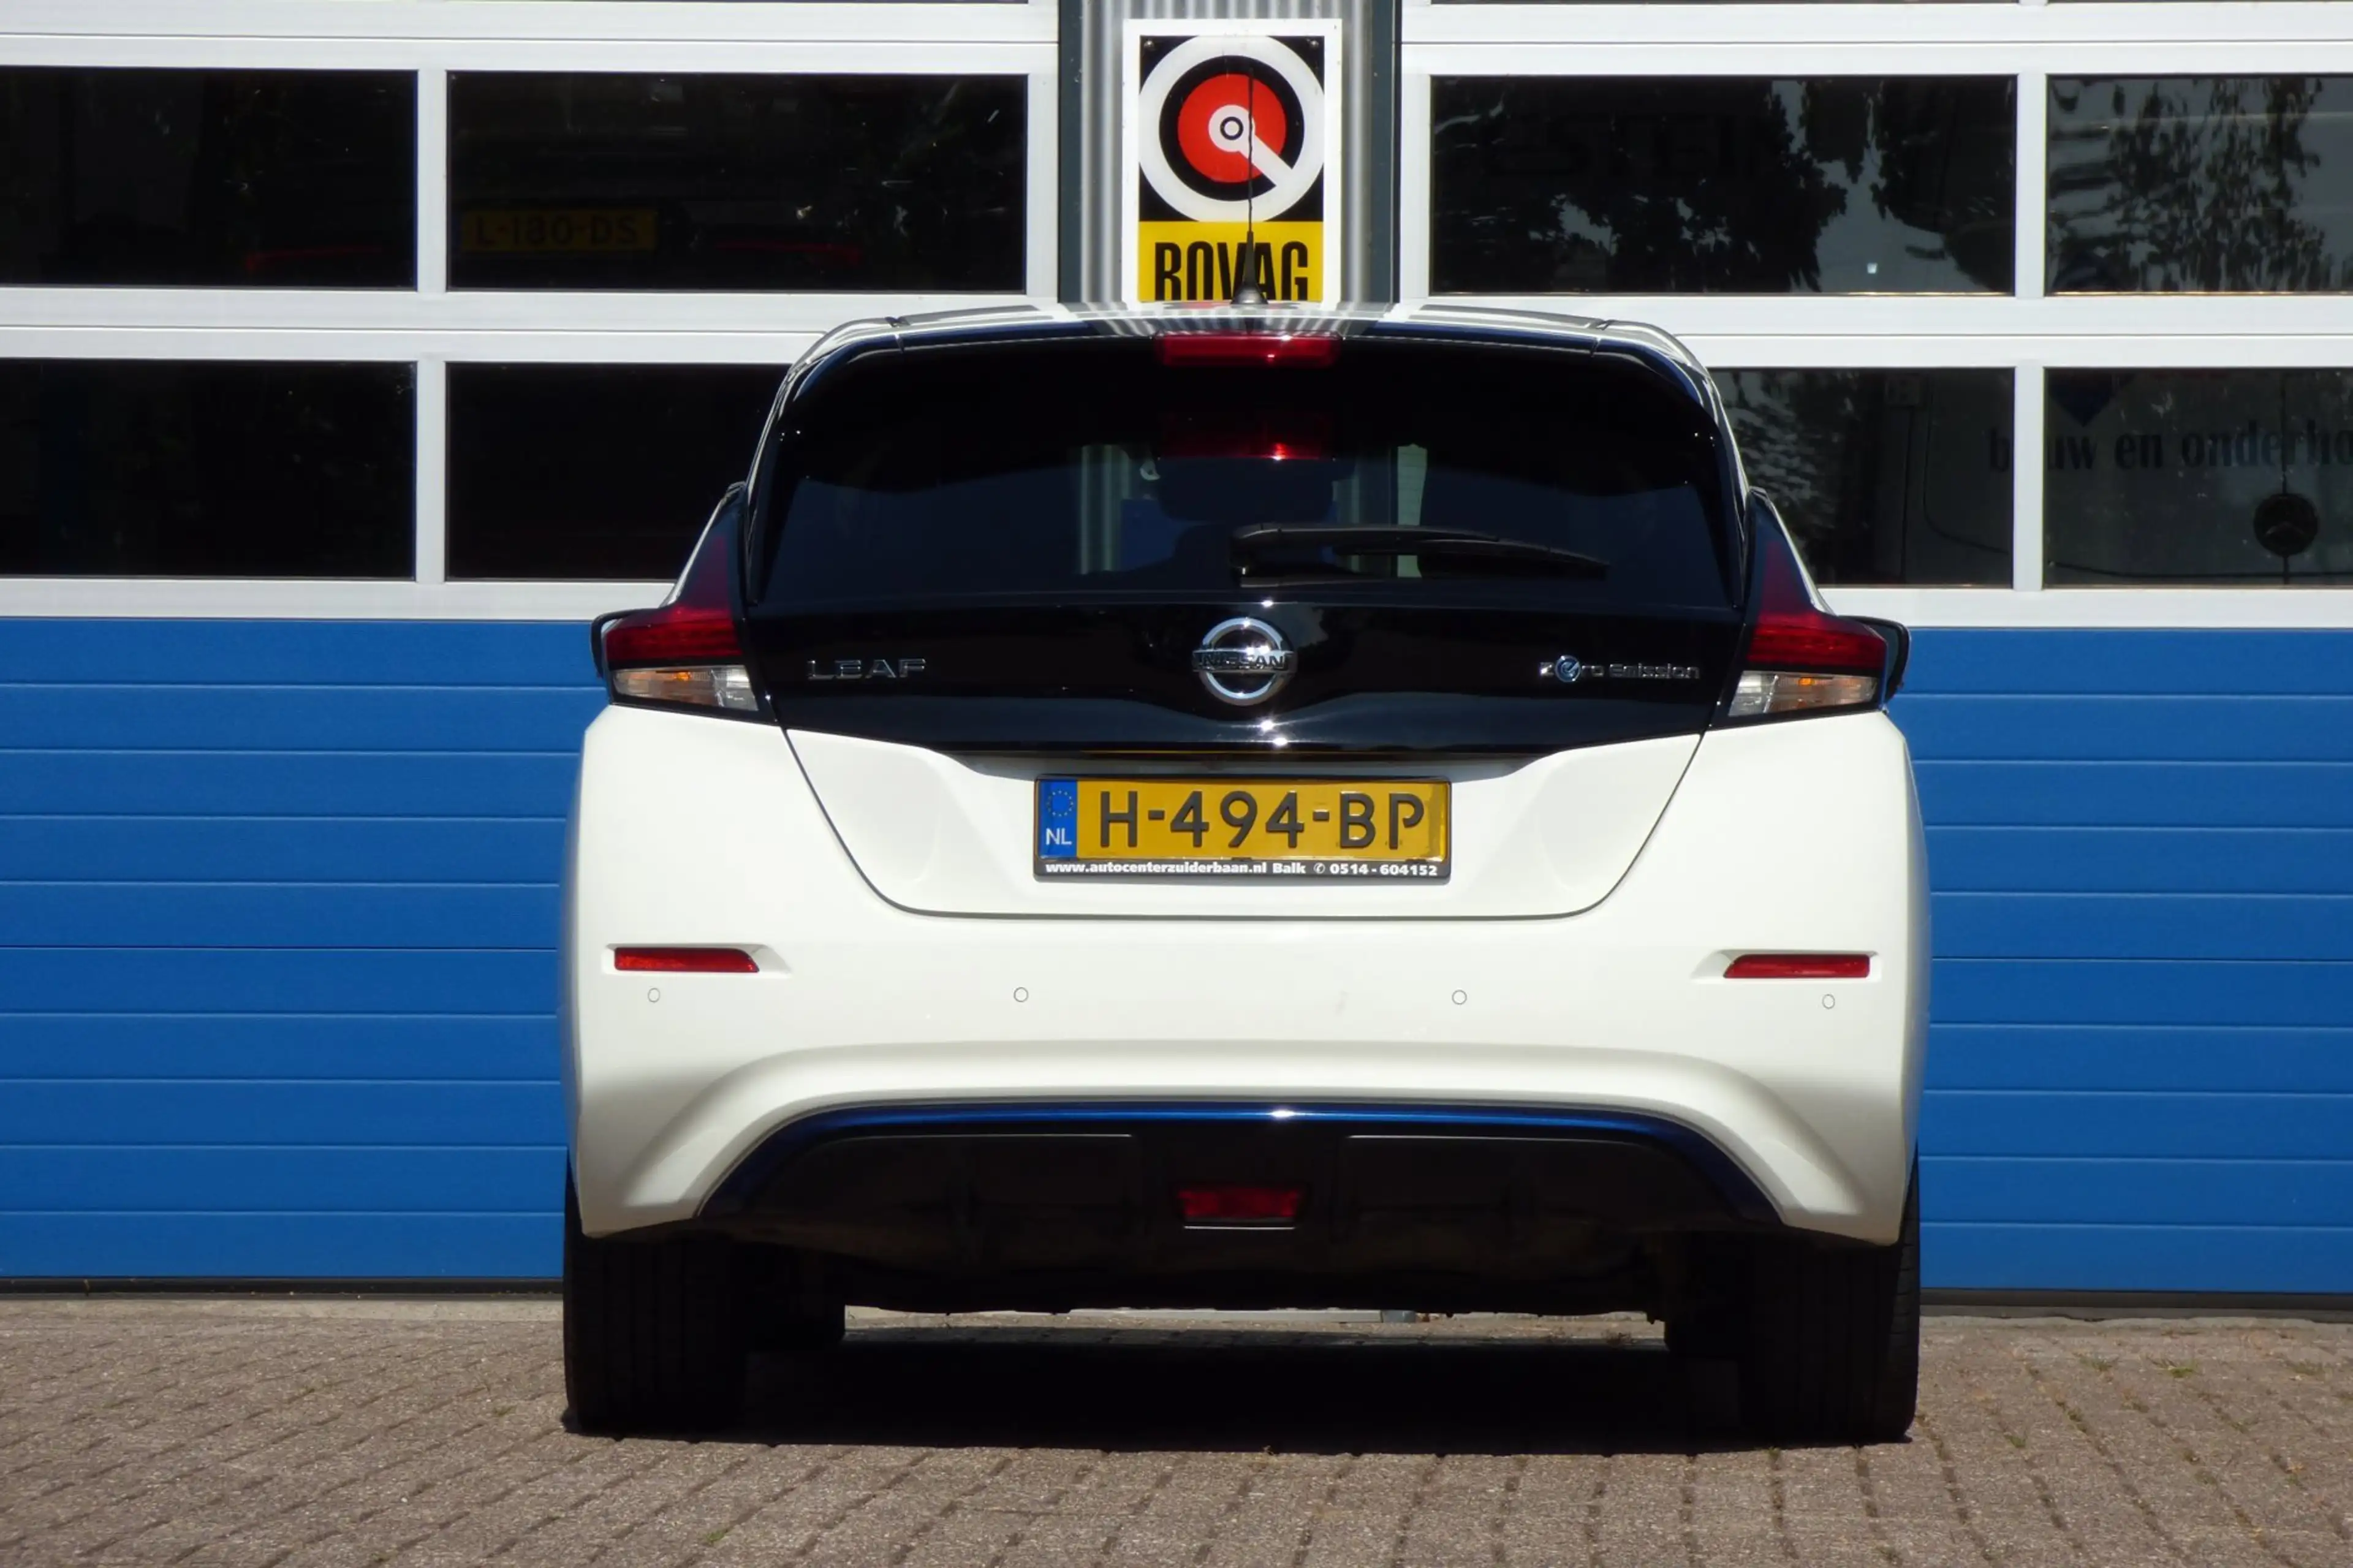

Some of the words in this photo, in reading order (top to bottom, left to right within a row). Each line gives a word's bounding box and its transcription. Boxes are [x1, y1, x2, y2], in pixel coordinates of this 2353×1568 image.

[2113, 431, 2162, 469] en
[806, 658, 926, 680] LEAF
[1099, 790, 1425, 849] H-494-BP
[1045, 827, 1072, 846] NL
[1045, 861, 1267, 874] www.autocenterzuiderbaan.nl
[1272, 862, 1306, 874] Balk
